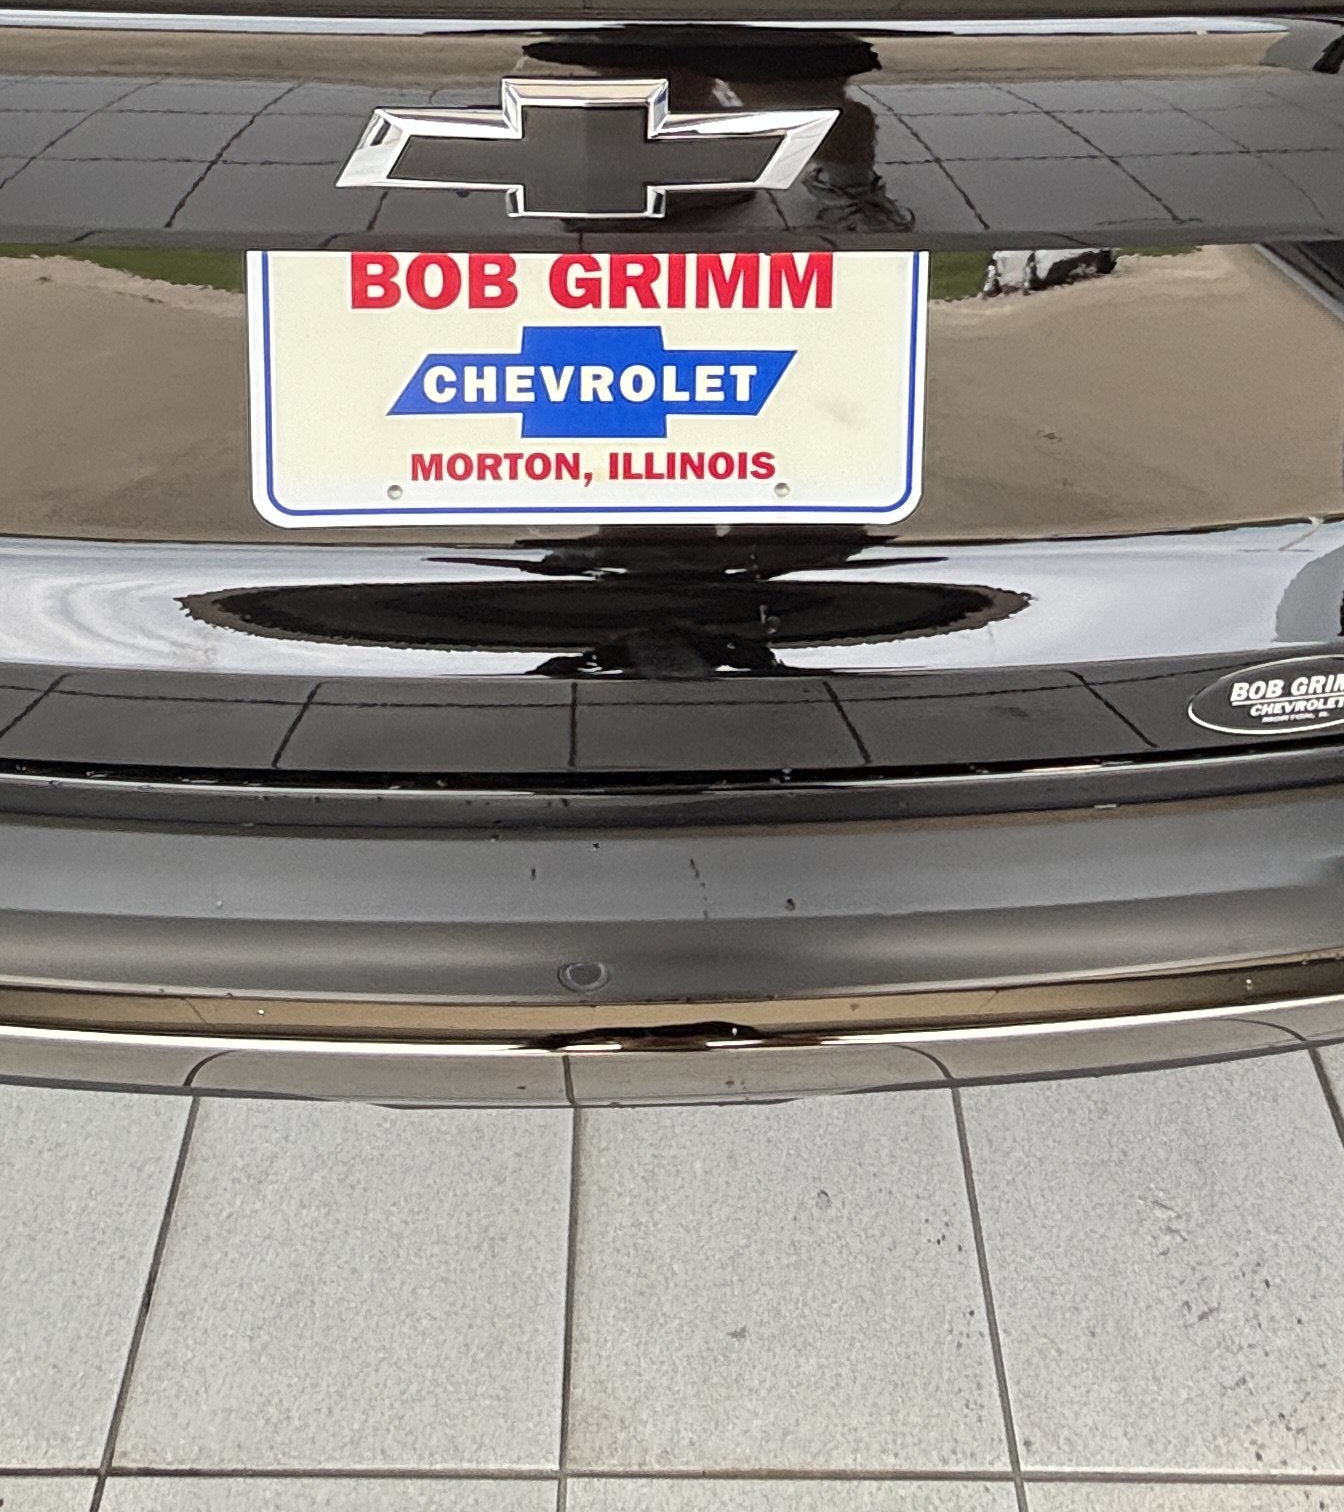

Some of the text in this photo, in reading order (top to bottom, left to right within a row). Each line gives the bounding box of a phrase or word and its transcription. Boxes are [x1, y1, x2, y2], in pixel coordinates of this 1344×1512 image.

[350, 252, 834, 311] BOB GRIMM
[422, 364, 758, 403] CHEVROLET
[410, 451, 776, 487] MORTON, ILLINOIS
[1230, 679, 1284, 702] BOB
